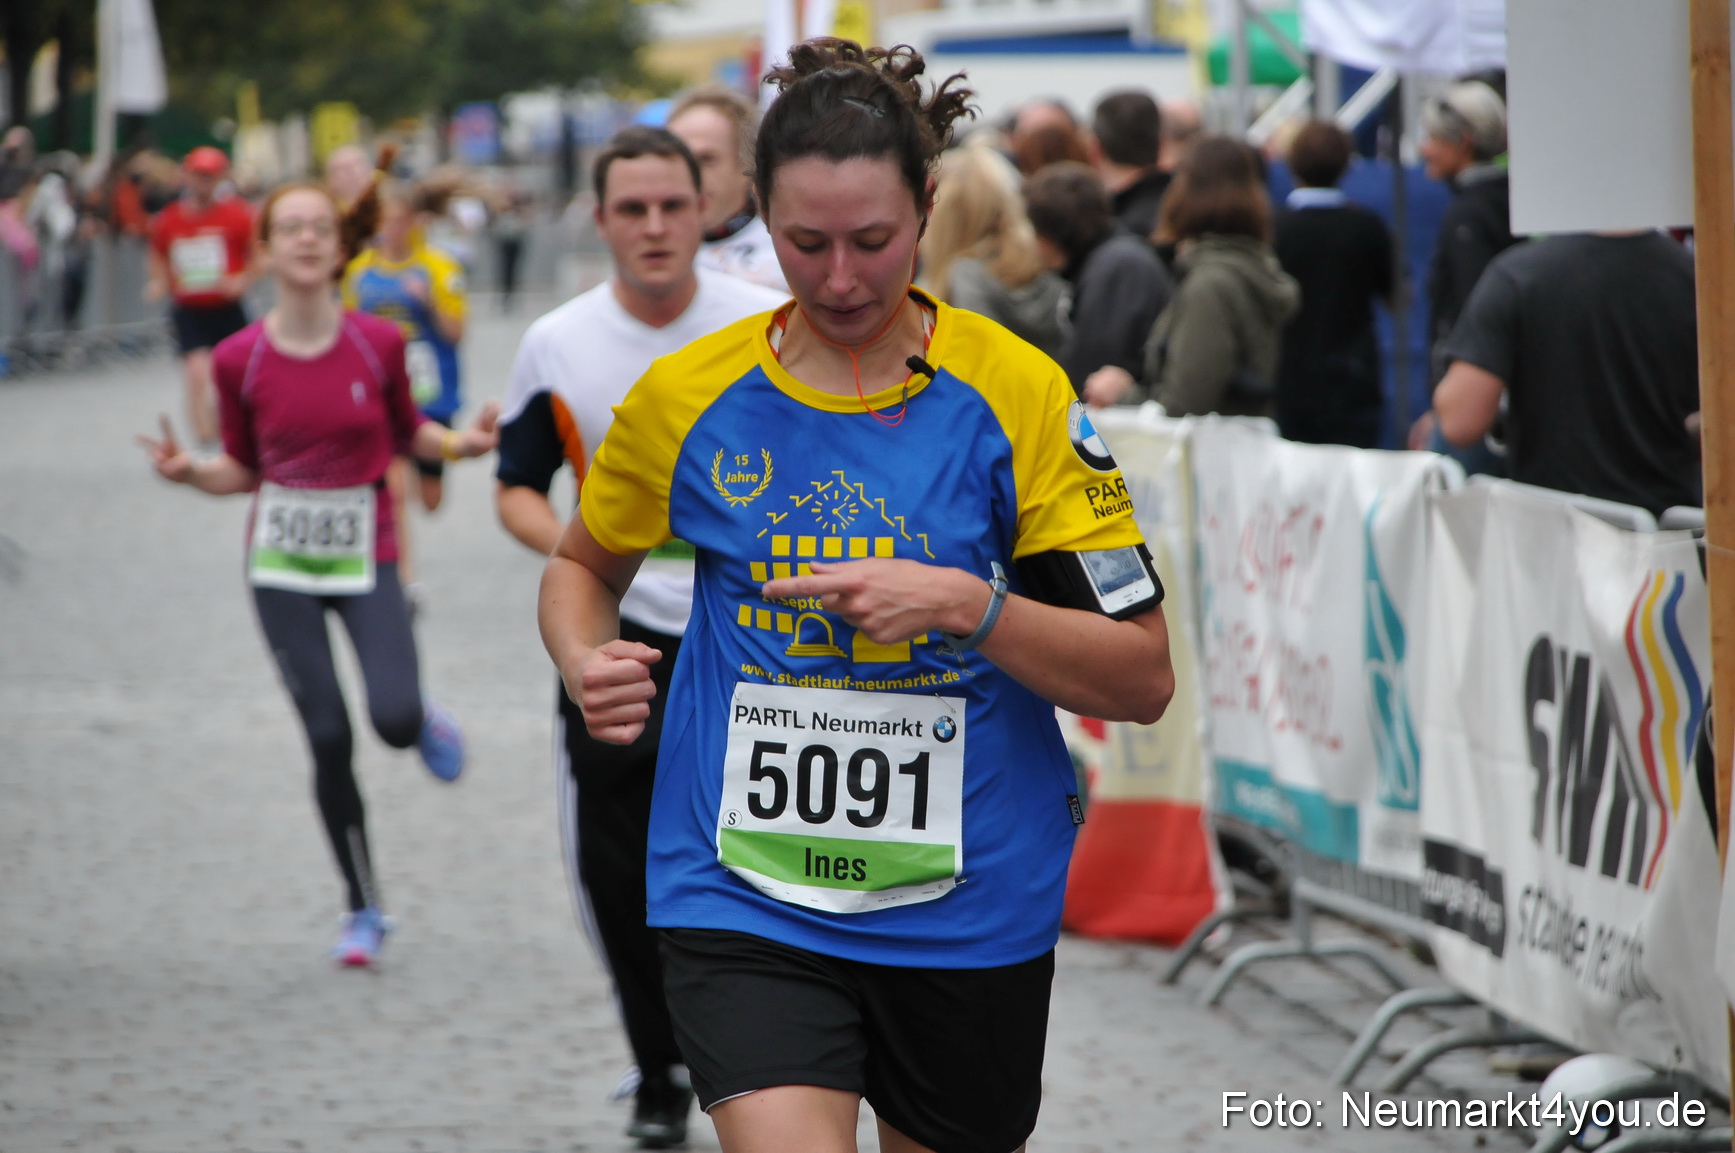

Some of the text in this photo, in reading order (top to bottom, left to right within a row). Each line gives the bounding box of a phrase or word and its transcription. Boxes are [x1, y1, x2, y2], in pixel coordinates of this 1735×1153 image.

[734, 454, 749, 466] 15
[724, 470, 759, 484] Jahre
[268, 505, 358, 547] 5083
[740, 663, 961, 691] www.stadtlauf-neumarkt.de
[734, 705, 805, 729] PARTL
[811, 712, 923, 738] Neumarkt
[747, 740, 930, 830] 5091
[727, 811, 737, 826] S
[804, 847, 867, 882] Ines
